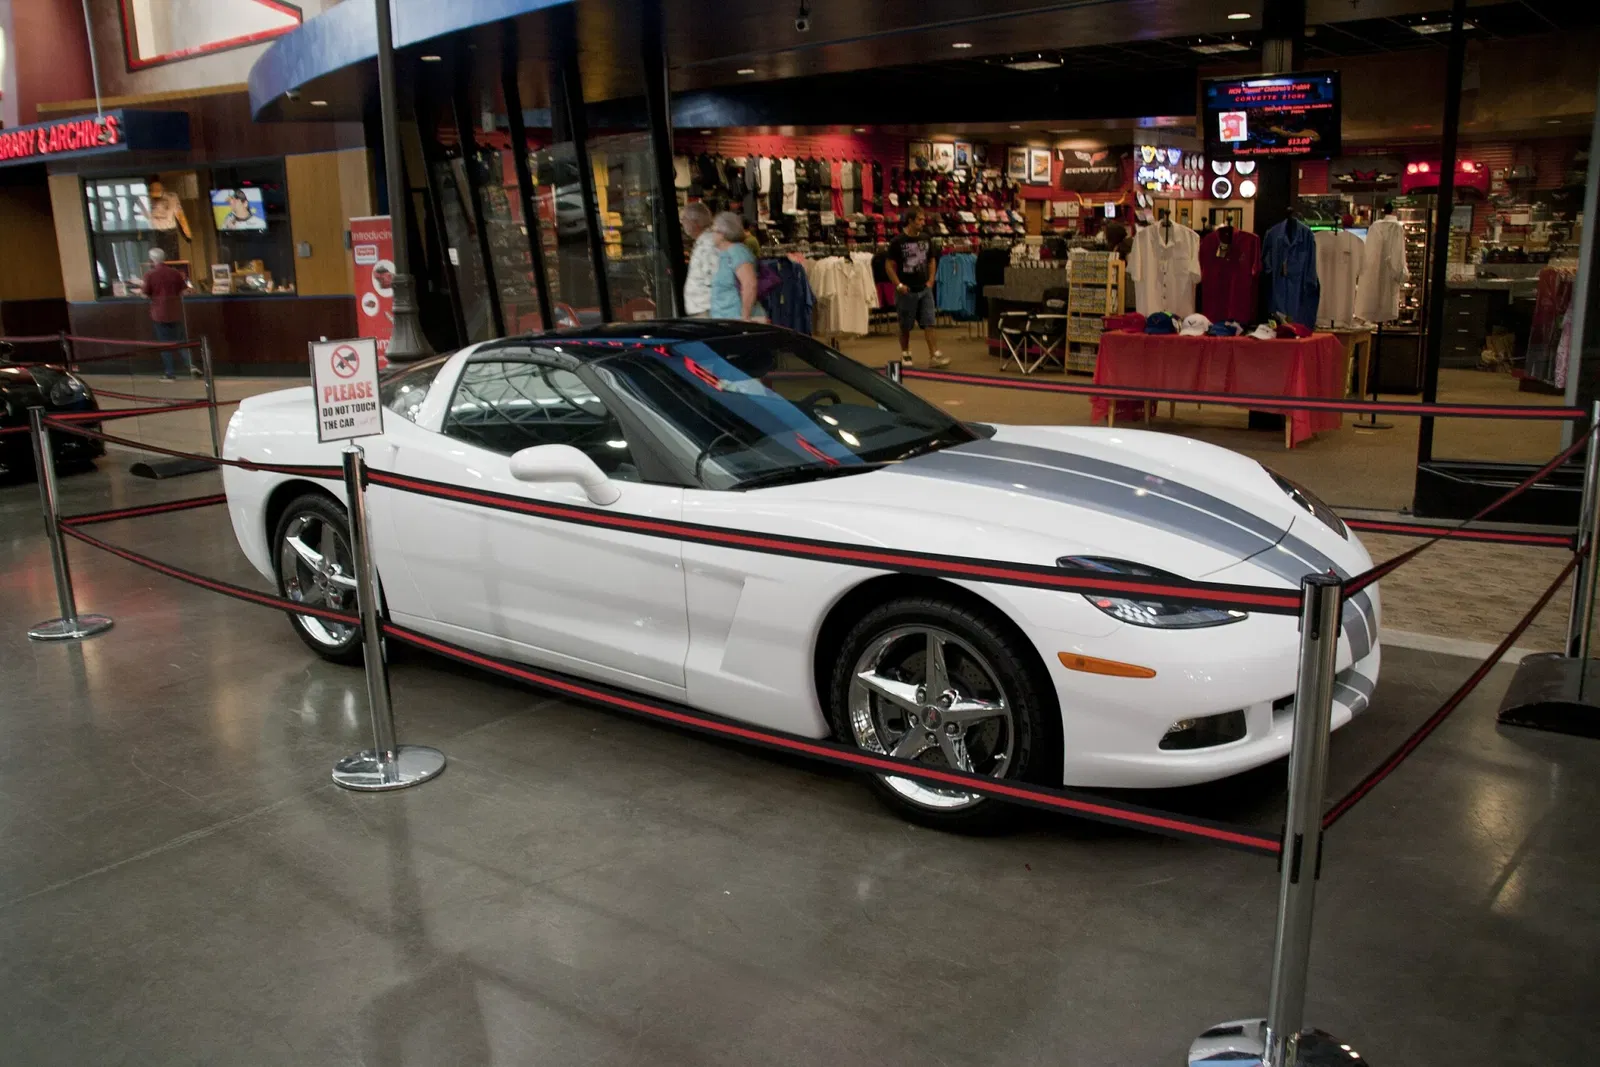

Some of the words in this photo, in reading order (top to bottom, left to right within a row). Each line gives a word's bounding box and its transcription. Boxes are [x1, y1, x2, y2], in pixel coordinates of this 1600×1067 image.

[37, 127, 48, 154] &
[1065, 167, 1117, 175] CORVETTE
[351, 228, 393, 242] Introducin
[324, 380, 374, 403] PLEASE
[322, 407, 334, 417] DO
[335, 404, 350, 416] NOT
[351, 401, 376, 413] TOUCH
[323, 419, 338, 431] THE
[339, 417, 355, 429] CAR
